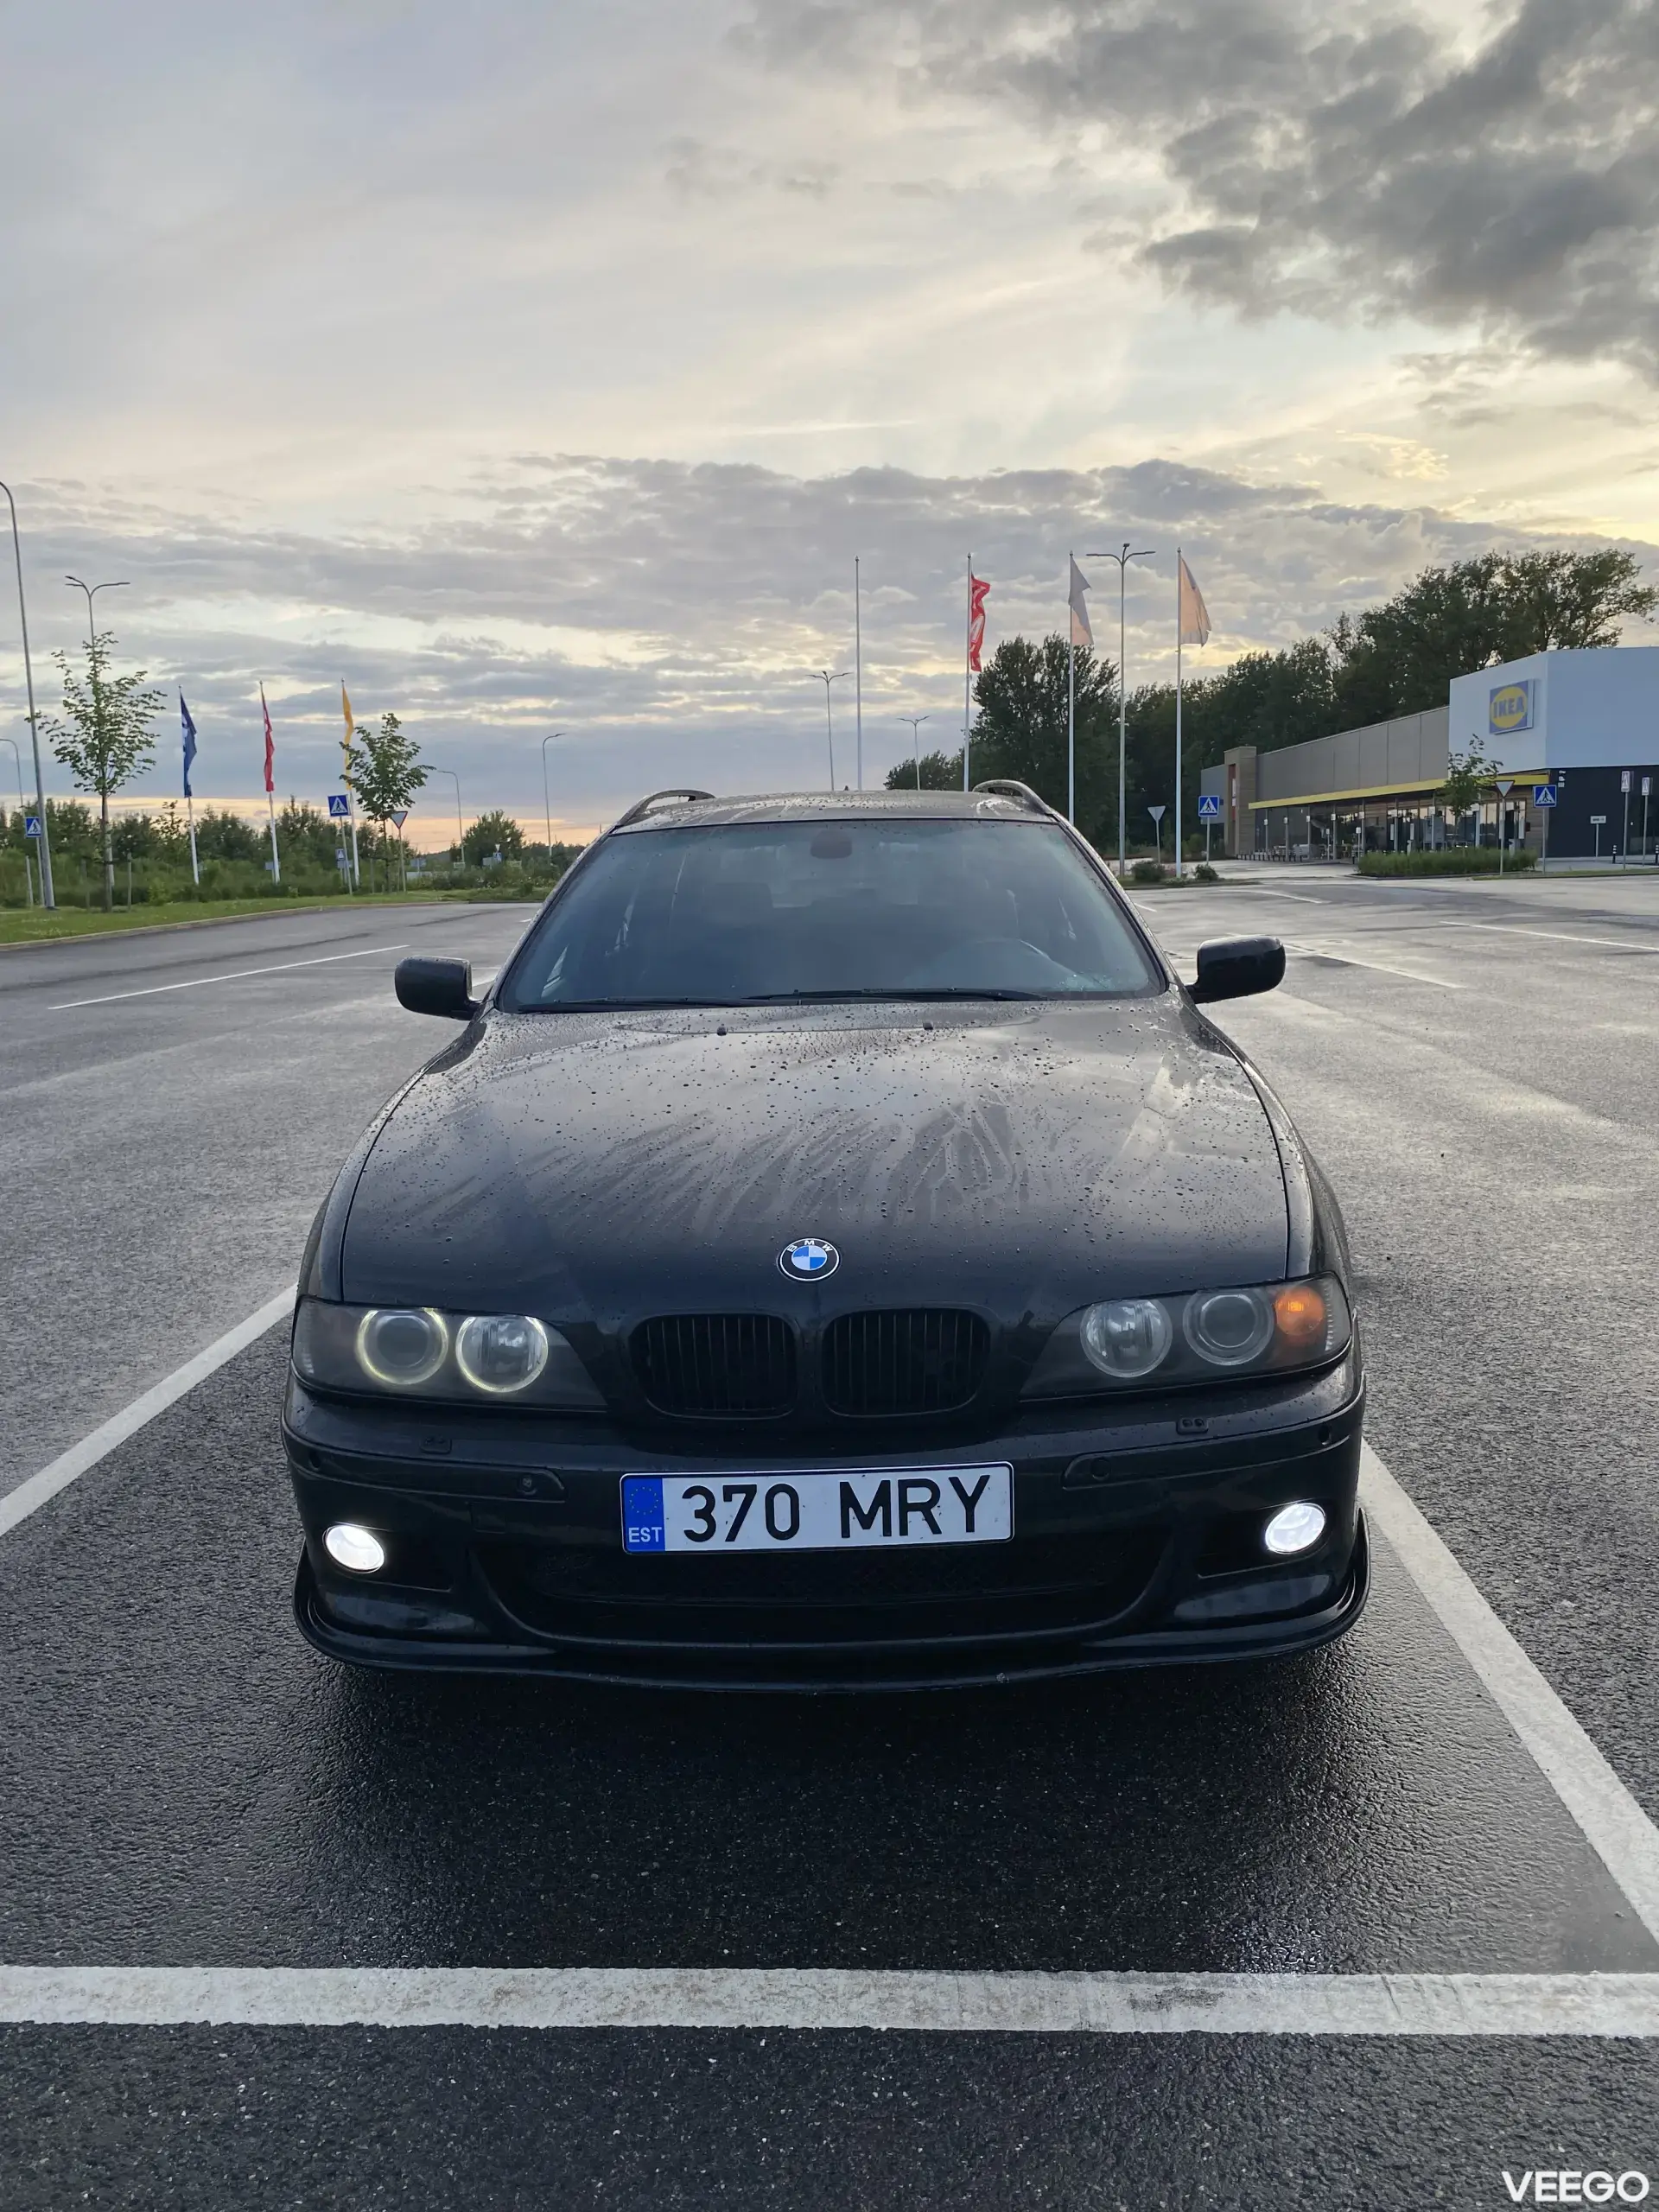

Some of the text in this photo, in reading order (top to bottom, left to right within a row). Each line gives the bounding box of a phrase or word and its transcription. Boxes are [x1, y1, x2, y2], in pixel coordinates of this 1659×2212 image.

[1492, 696, 1525, 718] IKEA
[786, 1240, 833, 1253] BMW
[682, 1474, 990, 1542] 370 MRY
[628, 1526, 663, 1543] EST
